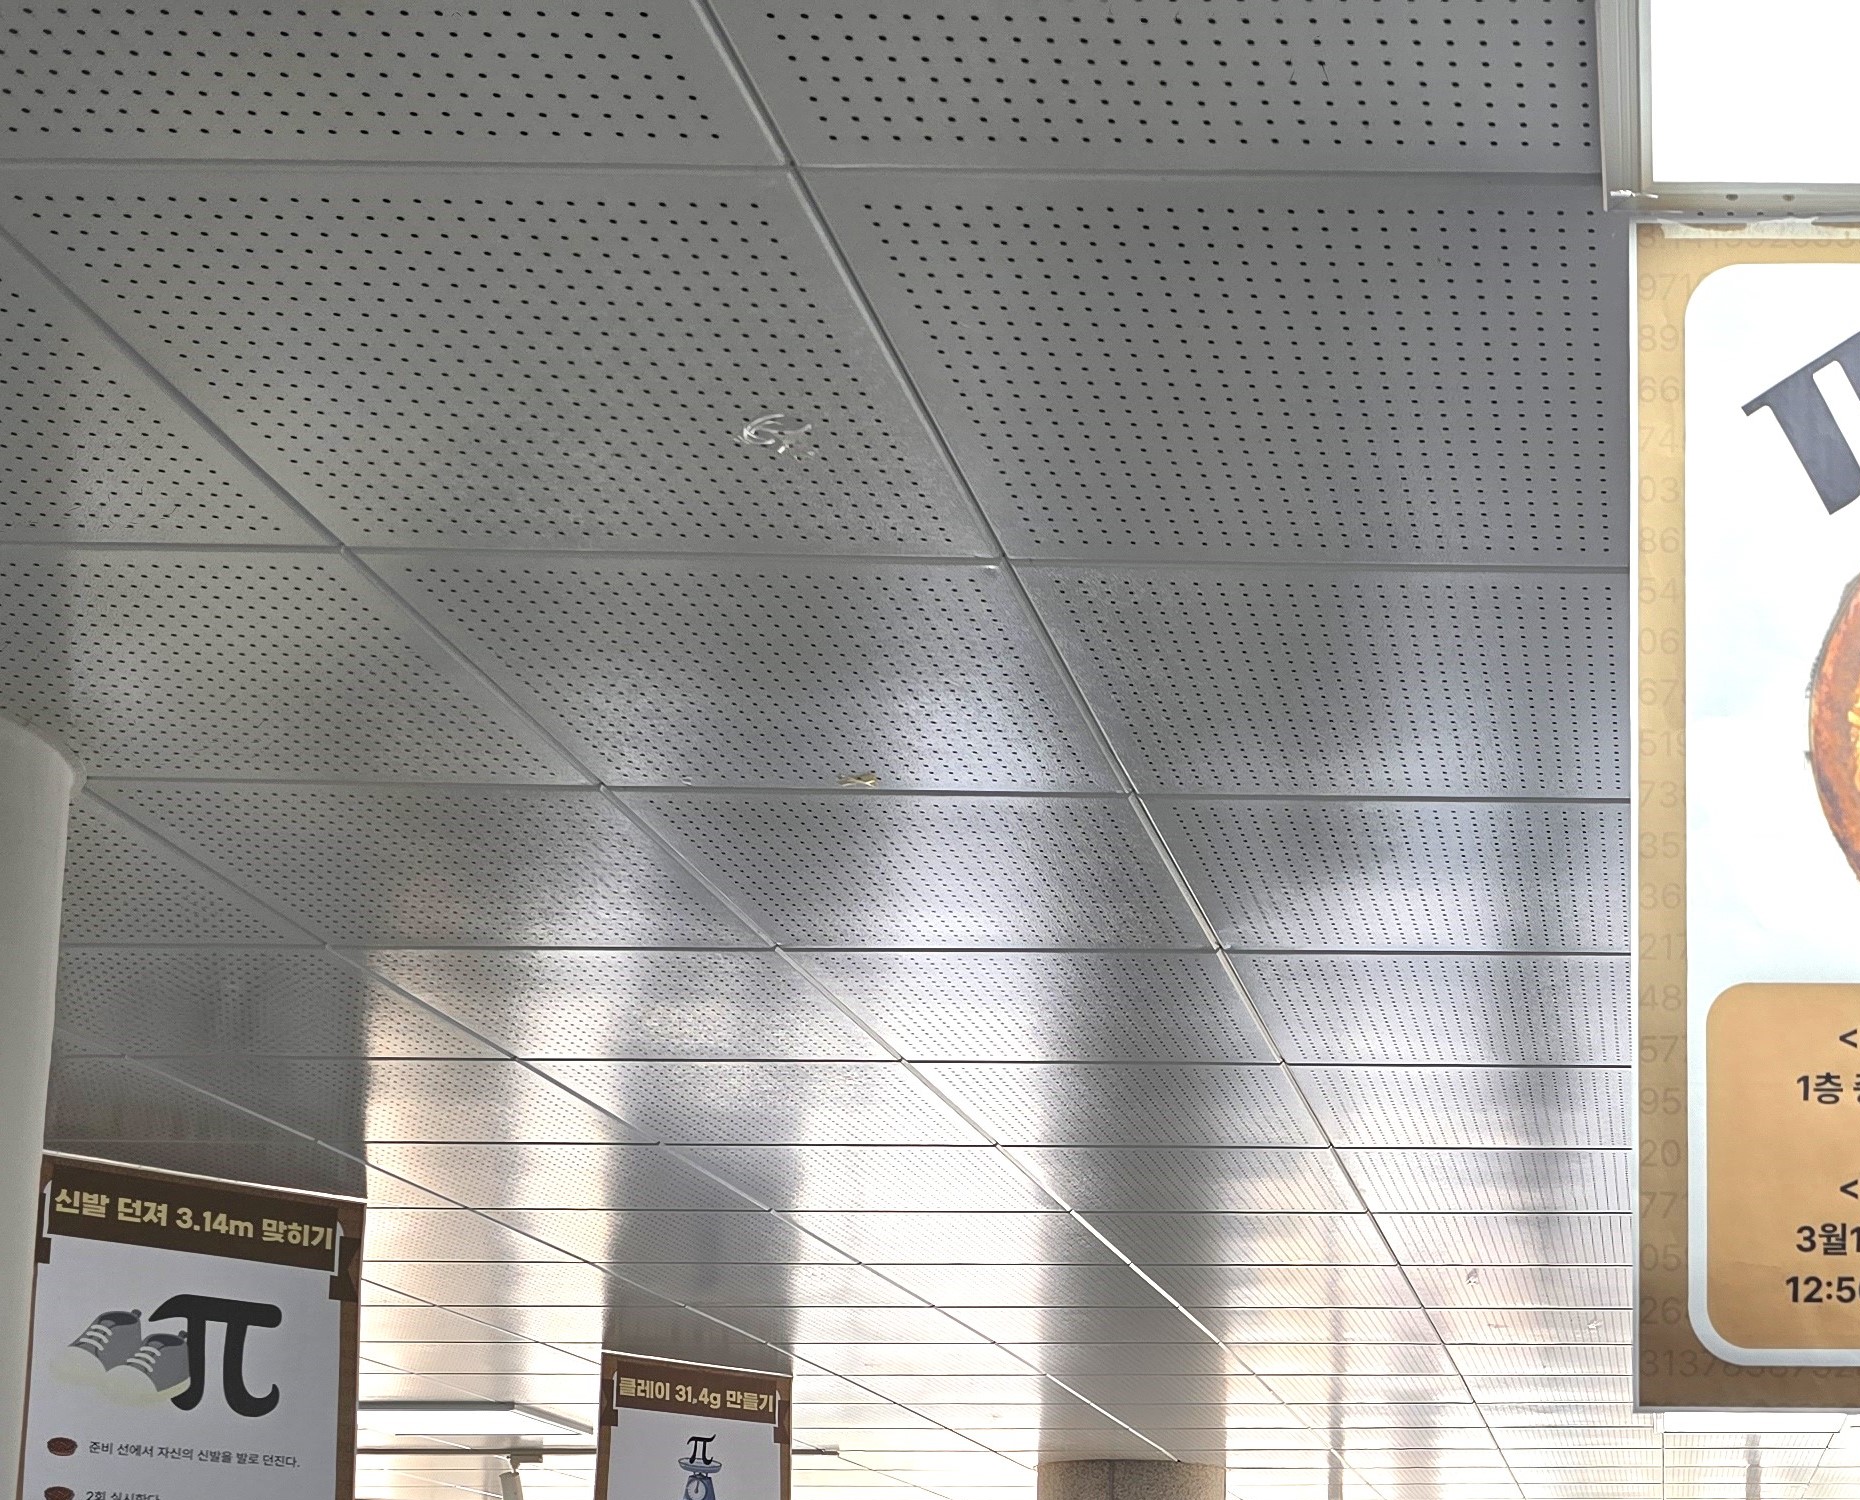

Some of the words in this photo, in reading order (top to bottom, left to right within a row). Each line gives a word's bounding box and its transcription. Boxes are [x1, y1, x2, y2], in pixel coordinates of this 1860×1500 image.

[1796, 1072, 1843, 1105] 1층
[55, 1188, 110, 1219] 신발
[117, 1197, 168, 1227] 던져
[176, 1207, 254, 1239] 3.14m
[261, 1218, 333, 1250] 맞히기
[619, 1377, 670, 1401] 클레이
[726, 1390, 774, 1413] 만들기
[89, 1441, 113, 1455] 준비
[116, 1443, 153, 1458] 선에서
[157, 1446, 194, 1460] 자신의
[198, 1449, 233, 1464] 신발을
[236, 1452, 260, 1465] 발로
[262, 1453, 301, 1468] 던진다.
